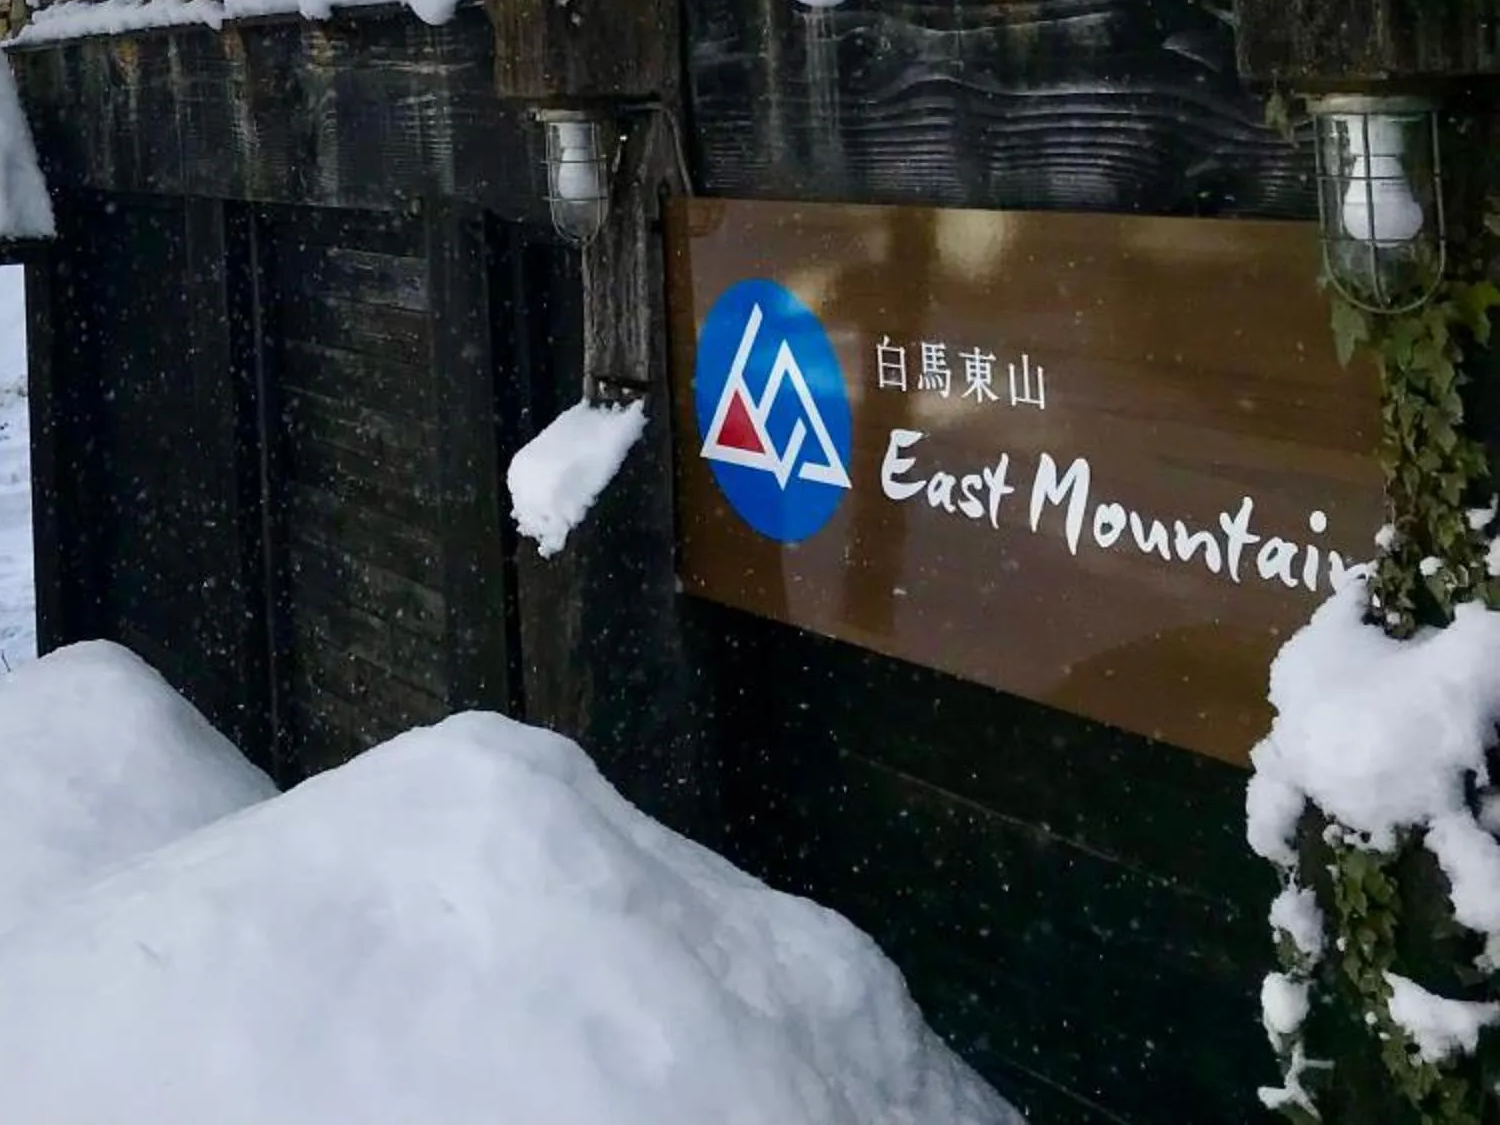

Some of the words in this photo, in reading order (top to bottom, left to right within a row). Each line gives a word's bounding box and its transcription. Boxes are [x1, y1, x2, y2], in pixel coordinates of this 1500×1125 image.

[876, 334, 1045, 410] 白馬東山
[880, 428, 1015, 530] East
[1030, 452, 1372, 595] Mountain
